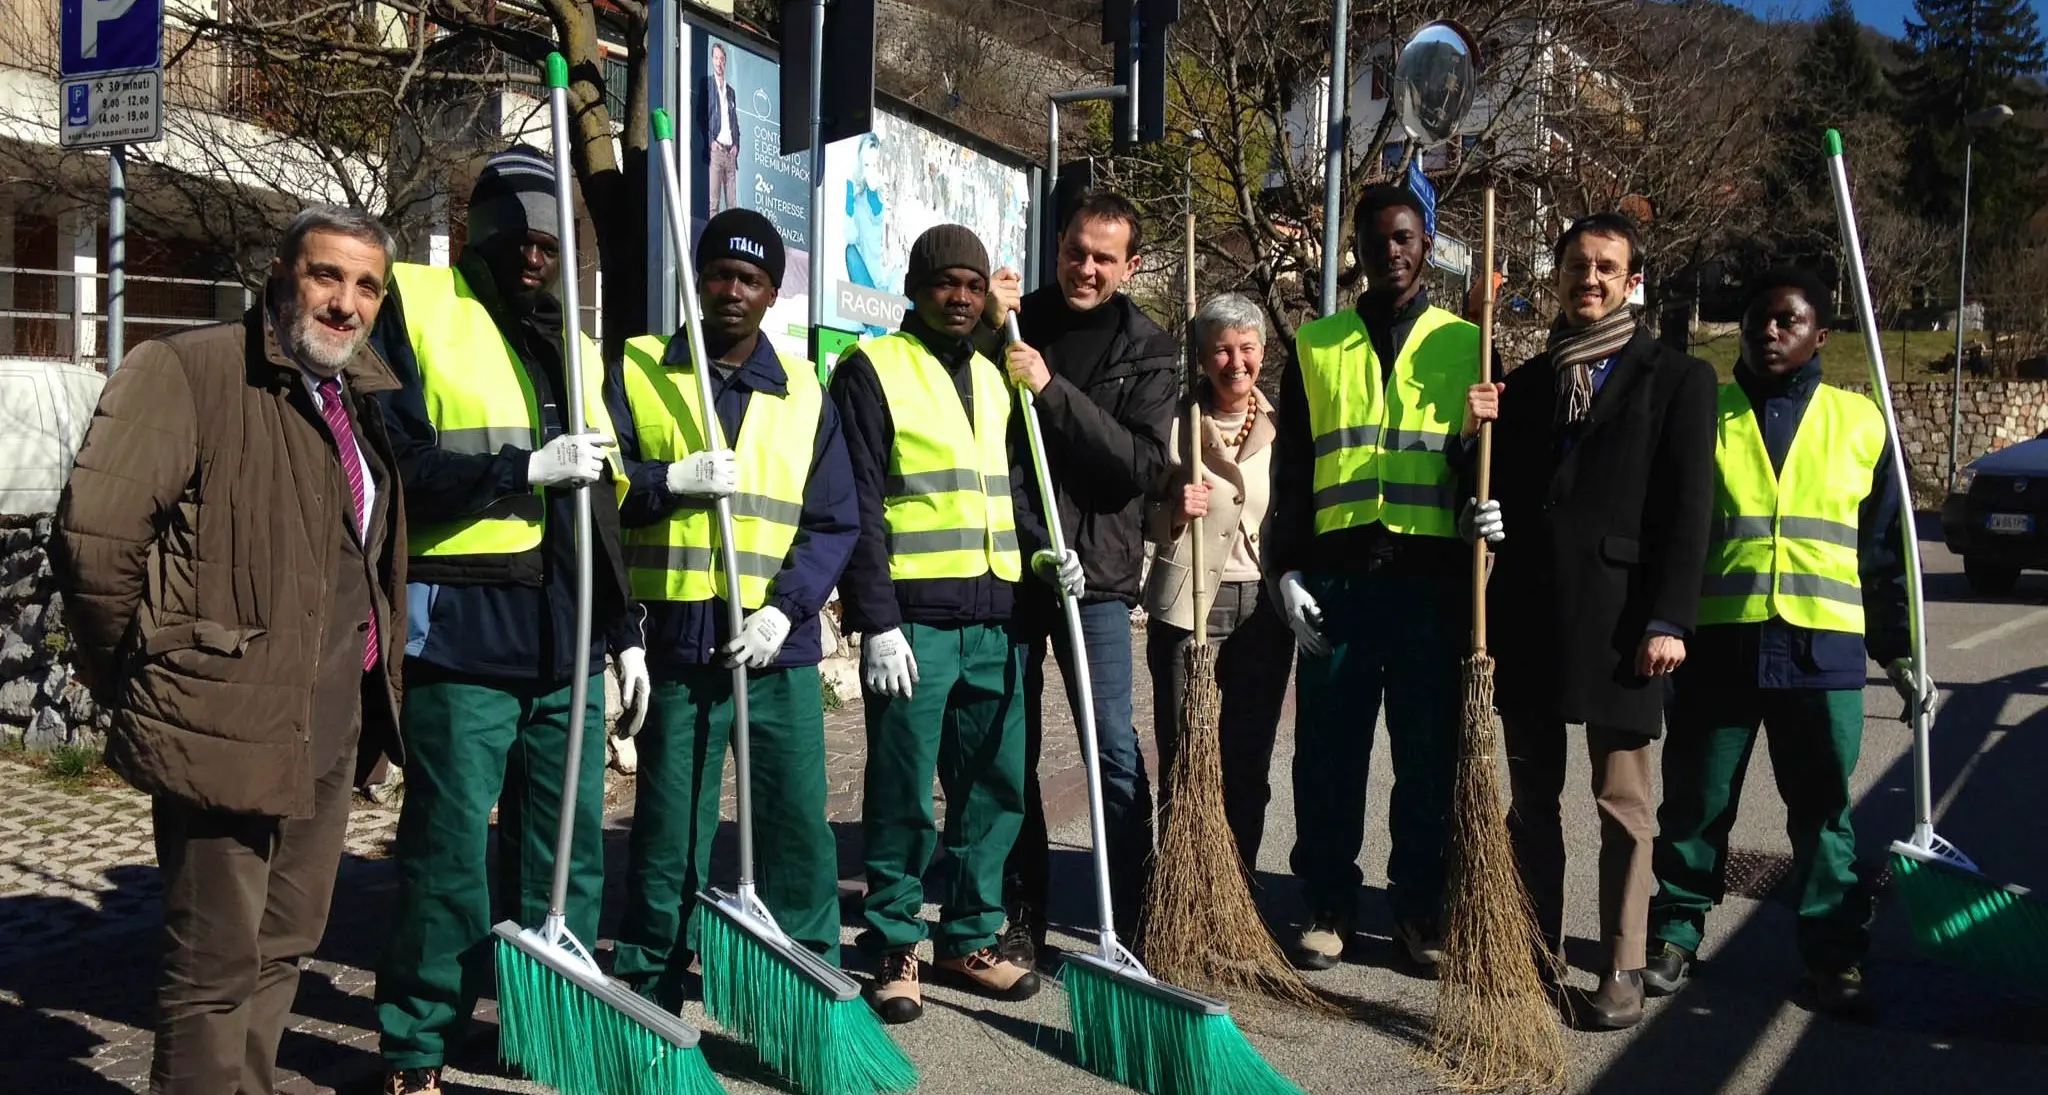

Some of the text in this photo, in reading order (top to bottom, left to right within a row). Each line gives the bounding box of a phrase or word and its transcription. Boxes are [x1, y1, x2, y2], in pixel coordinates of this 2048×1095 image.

[109, 78, 149, 92] 30 minuti
[102, 127, 130, 137] appositi
[754, 139, 760, 151] E
[754, 151, 810, 184] PREMIUM PACK
[730, 237, 764, 259] ITALIA
[841, 291, 904, 324] RAGNO
